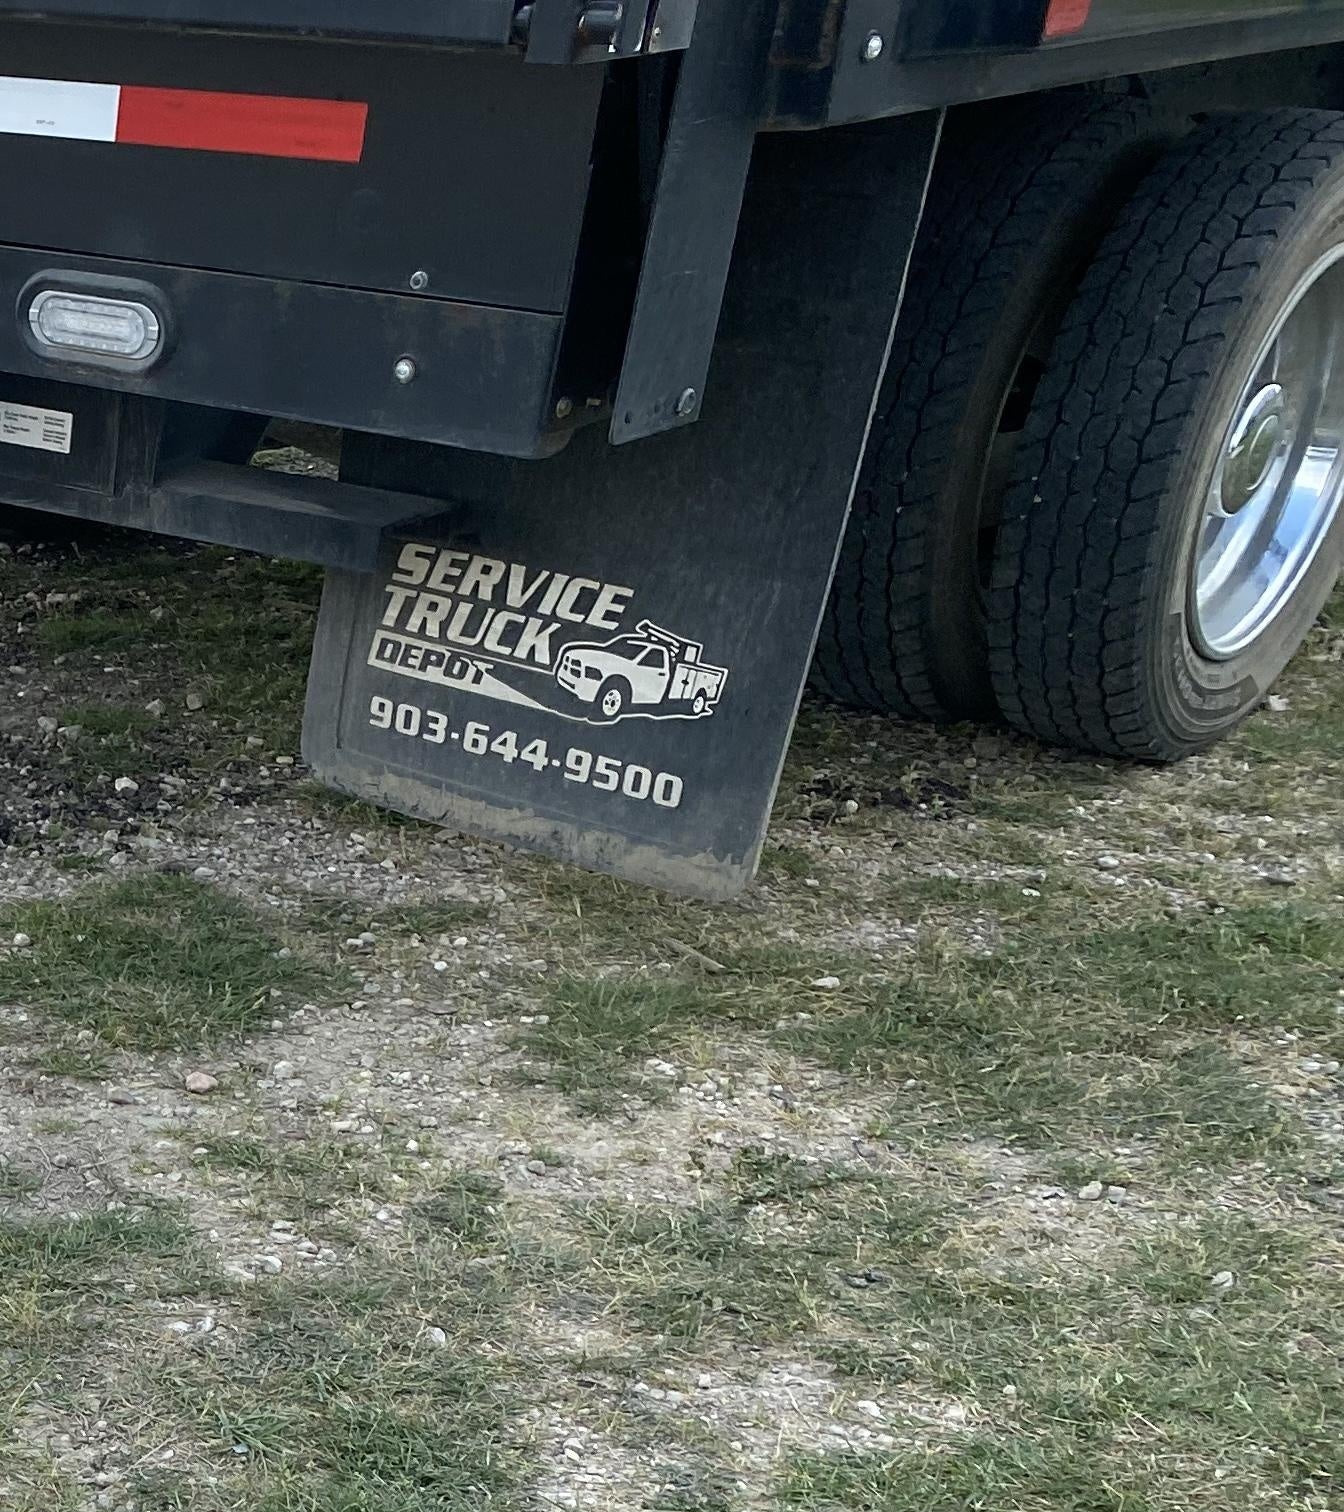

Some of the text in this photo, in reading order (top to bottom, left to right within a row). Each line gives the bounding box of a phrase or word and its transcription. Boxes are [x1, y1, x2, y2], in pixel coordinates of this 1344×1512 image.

[381, 583, 561, 666] TRUCK
[392, 541, 635, 630] SERVICE
[374, 637, 495, 685] DEPOT
[368, 695, 683, 809] 903-644-9500
